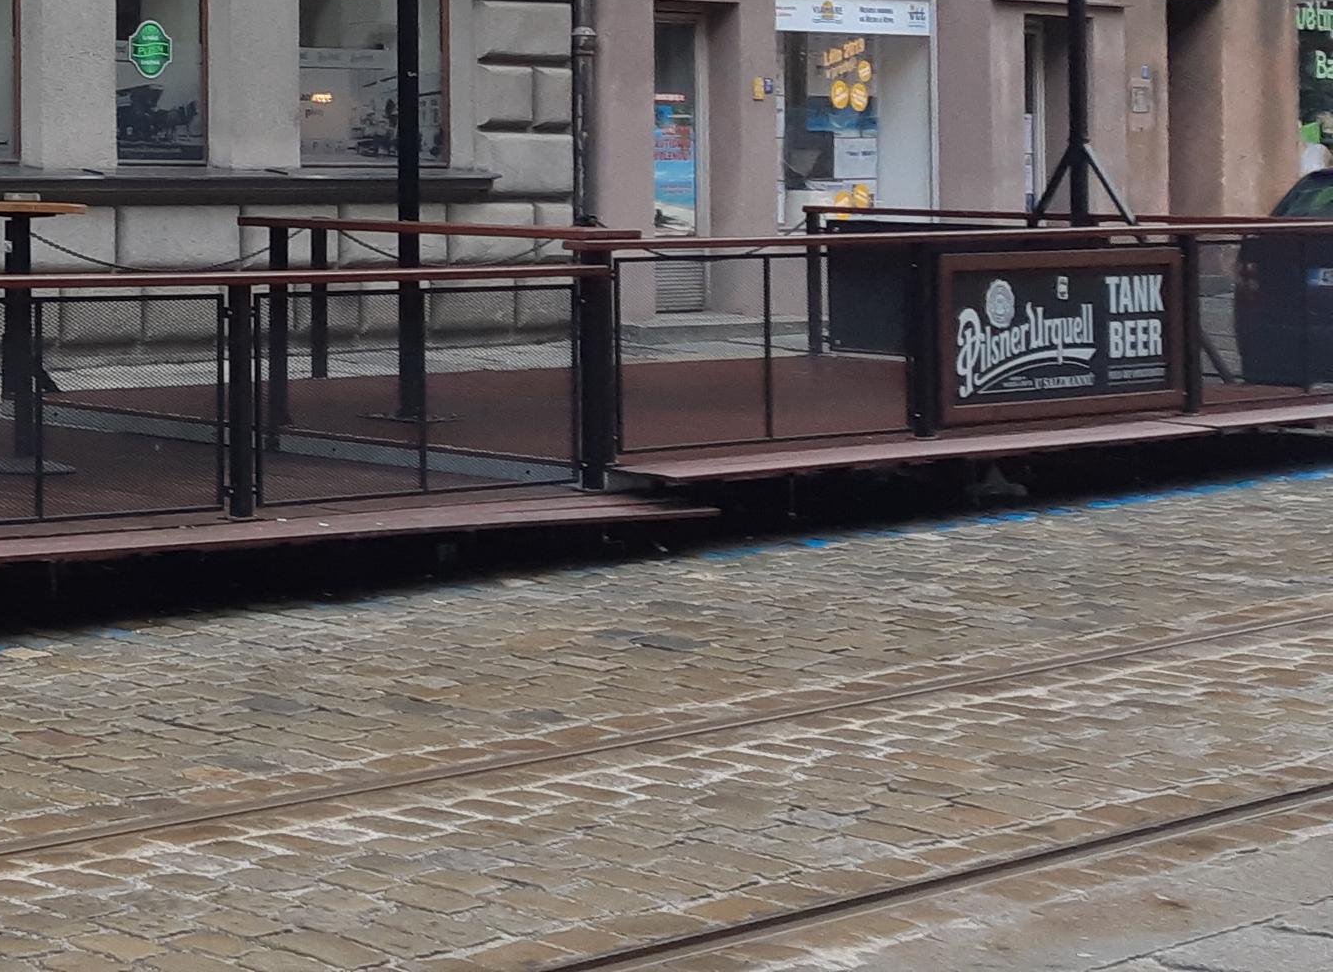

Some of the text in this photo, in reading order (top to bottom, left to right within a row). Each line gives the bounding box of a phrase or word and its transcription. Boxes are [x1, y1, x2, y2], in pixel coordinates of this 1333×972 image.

[1105, 274, 1165, 314] TANK
[956, 301, 1095, 399] Pilsner Urquell
[1108, 318, 1163, 359] BEER
